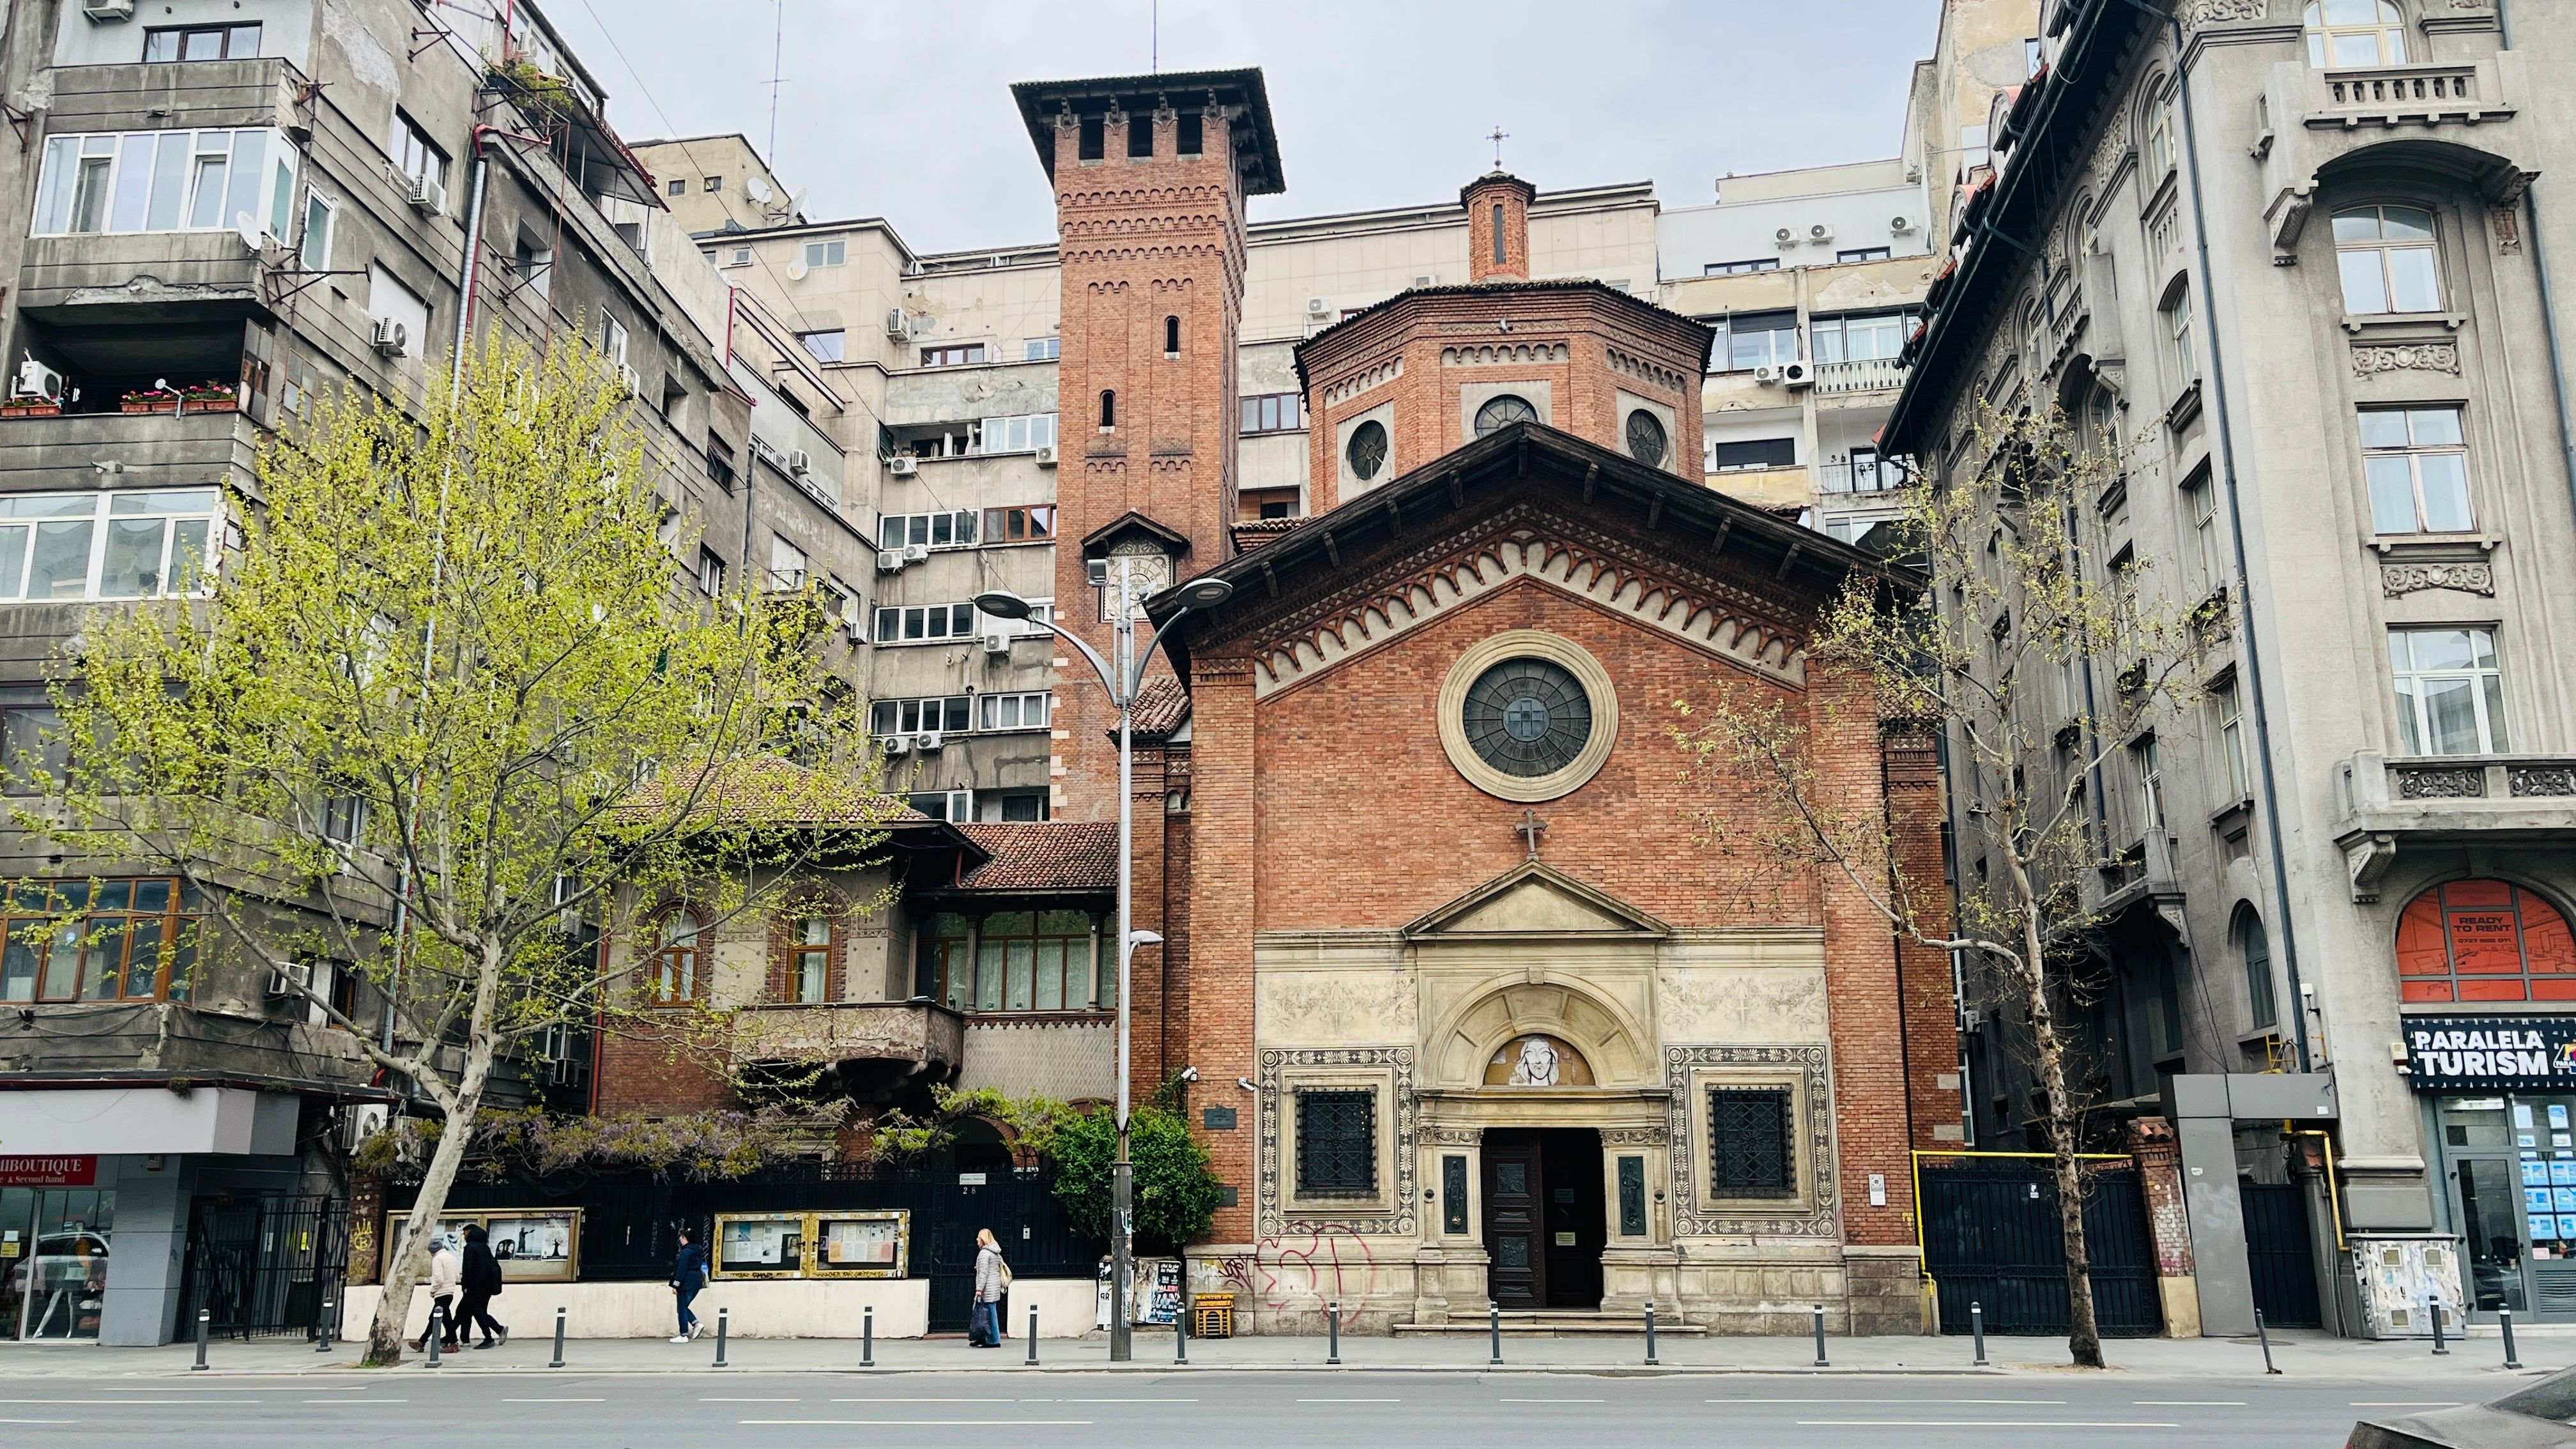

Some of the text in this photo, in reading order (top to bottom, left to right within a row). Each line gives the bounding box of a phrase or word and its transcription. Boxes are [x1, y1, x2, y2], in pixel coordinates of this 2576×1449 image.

[2414, 1030, 2546, 1050] PARALELA
[2417, 1050, 2549, 1076] TURISM
[16, 1175, 44, 1183] Second
[45, 1175, 66, 1183] hand
